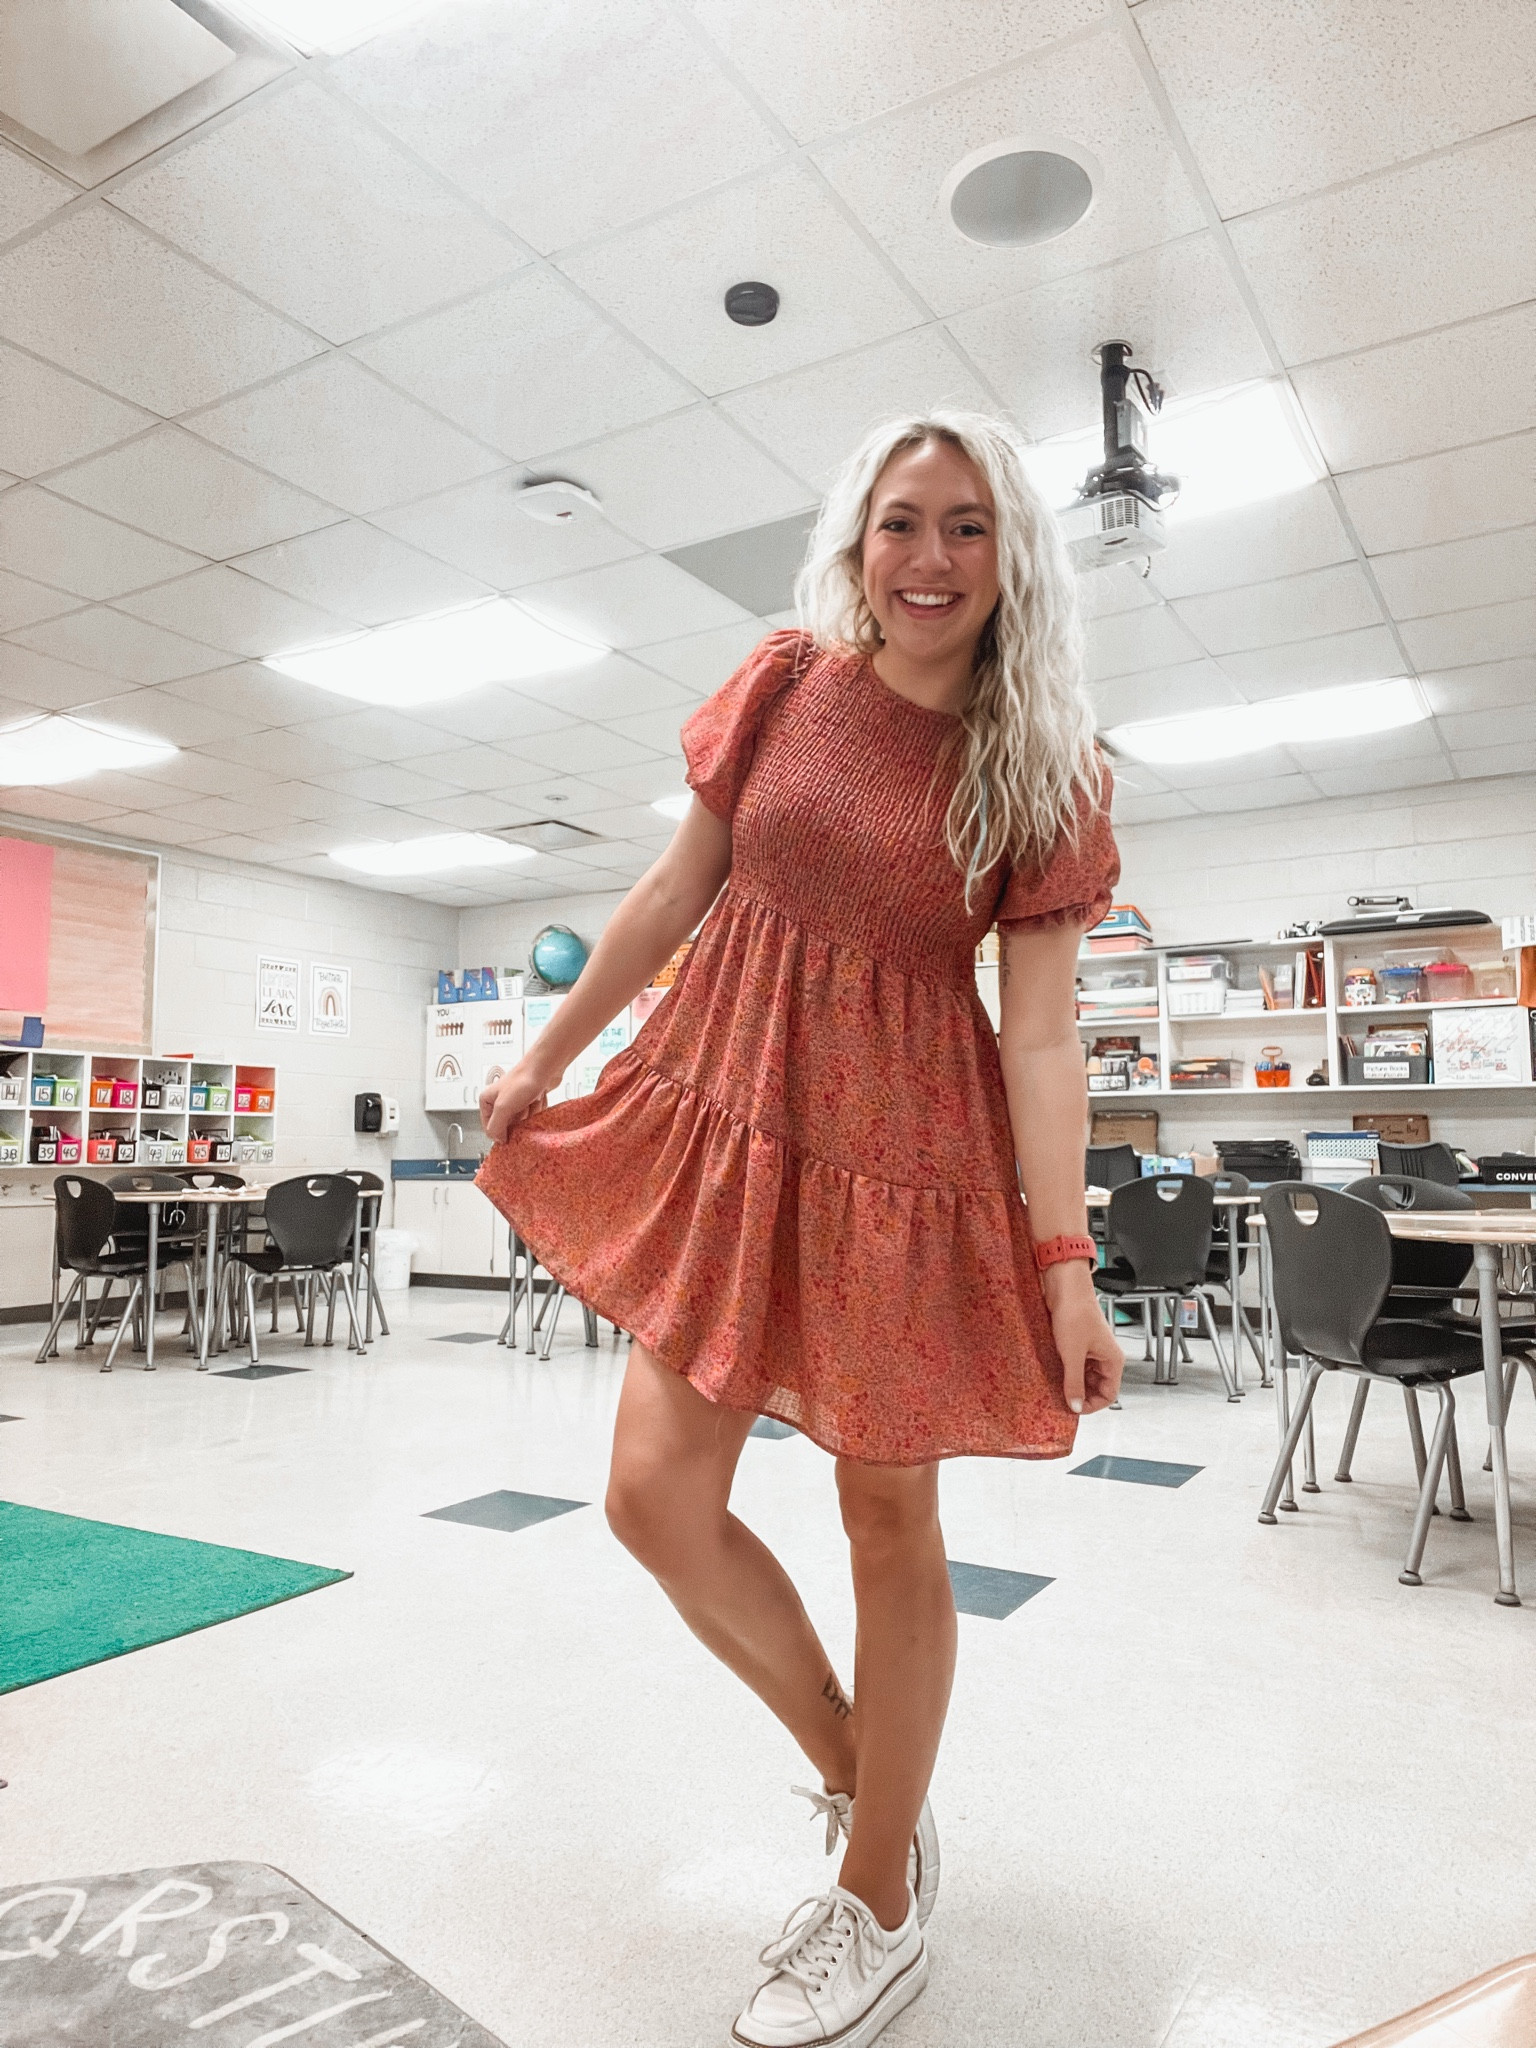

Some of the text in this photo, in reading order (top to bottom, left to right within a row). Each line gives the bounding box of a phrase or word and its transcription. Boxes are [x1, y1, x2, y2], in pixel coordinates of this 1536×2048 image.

[5, 1085, 16, 1100] 14
[38, 1088, 50, 1101] 15
[62, 1088, 74, 1101] 16
[98, 1090, 109, 1101] 17
[122, 1091, 132, 1103] 18
[148, 1092, 158, 1104] 19
[169, 1094, 182, 1106] 20
[194, 1093, 204, 1104] 21
[214, 1095, 226, 1106] 22
[259, 1097, 270, 1107] 24
[0, 1148, 18, 1160] 38
[39, 1147, 54, 1159] 39
[62, 1147, 78, 1157] 40
[98, 1149, 110, 1159] 41
[120, 1147, 133, 1158] 42
[150, 1149, 162, 1159] 43
[172, 1150, 184, 1160] 44
[194, 1147, 207, 1157] 45
[218, 1148, 230, 1158] 46
[243, 1148, 256, 1160] 47
[261, 1149, 273, 1159] 48
